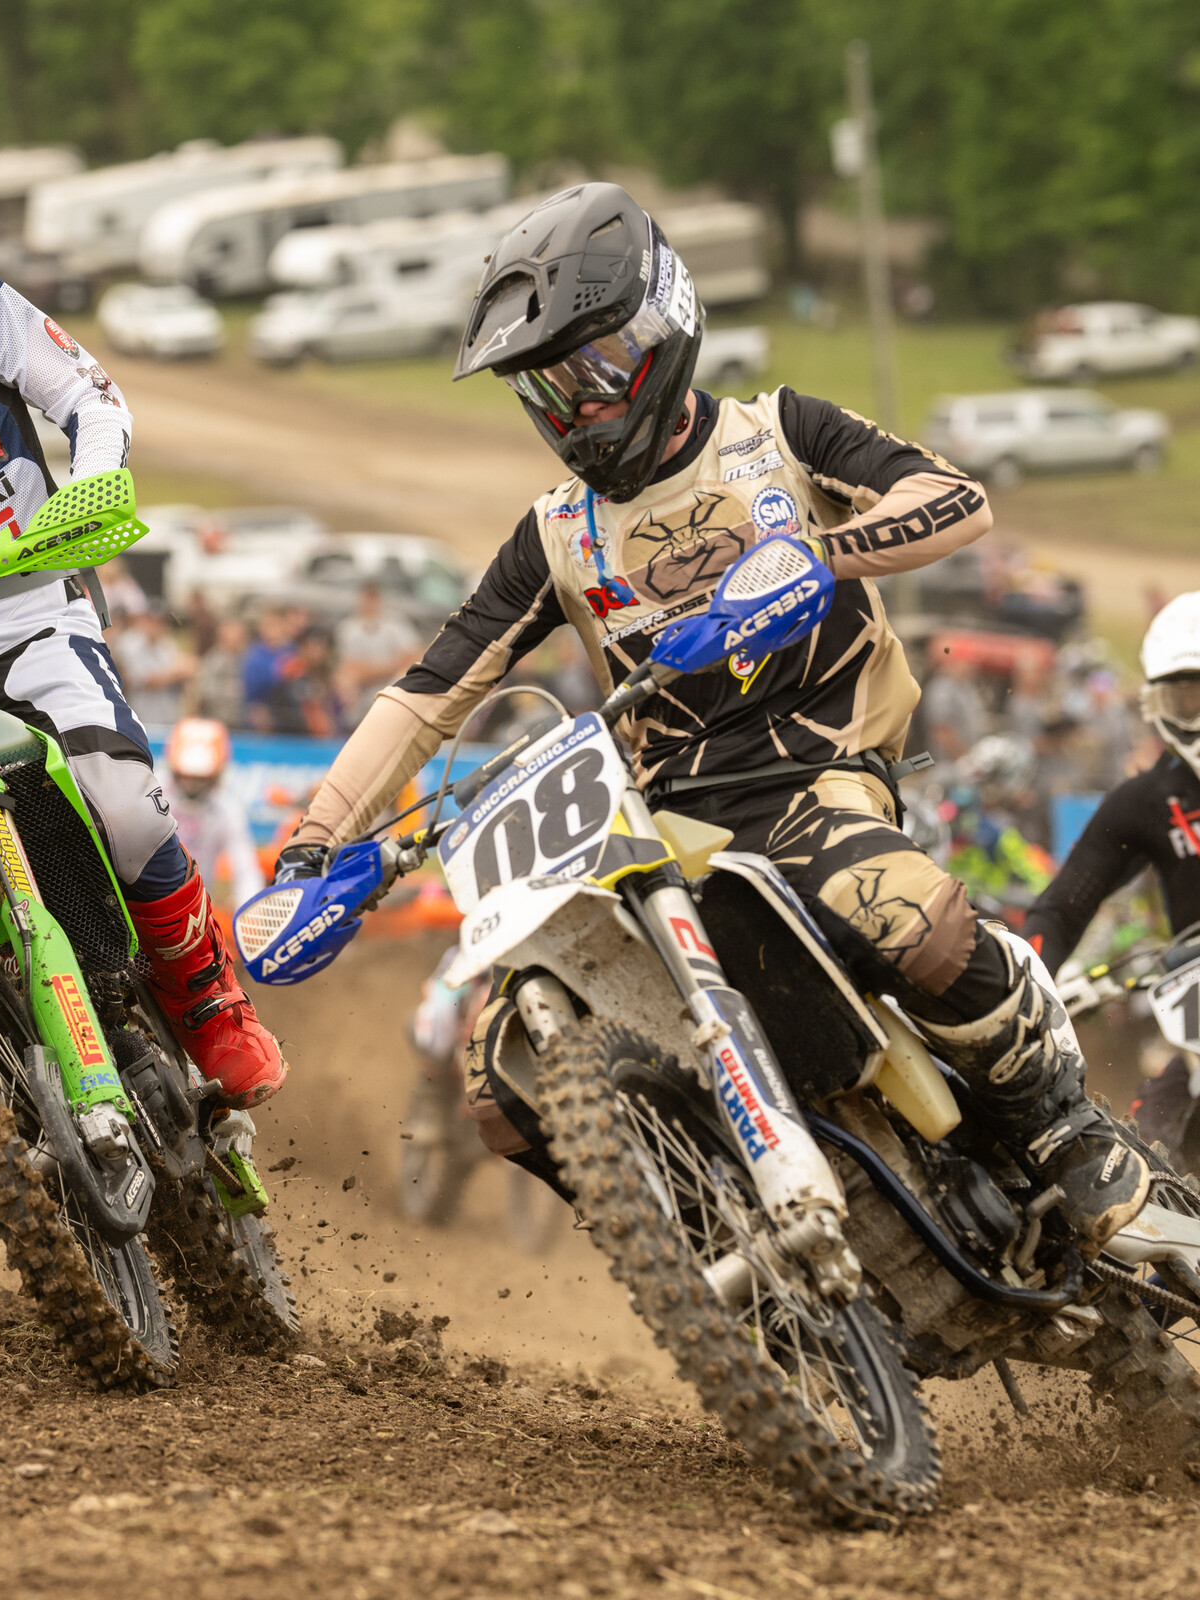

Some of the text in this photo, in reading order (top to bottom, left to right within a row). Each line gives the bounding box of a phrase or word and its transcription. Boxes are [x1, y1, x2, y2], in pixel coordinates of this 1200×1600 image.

[45, 320, 72, 348] RED LINE
[16, 520, 102, 561] ACERBIS
[759, 499, 792, 525] SM
[821, 484, 985, 557] MOOSE
[599, 608, 666, 648] alpinestars
[724, 580, 820, 651] ACERBIS
[472, 723, 596, 825] GNCCRACING.COM
[474, 749, 610, 898] 08
[261, 904, 346, 977] ACERBIS
[52, 975, 106, 1067] PIRELLI
[719, 1048, 780, 1151] UNLIMITED
